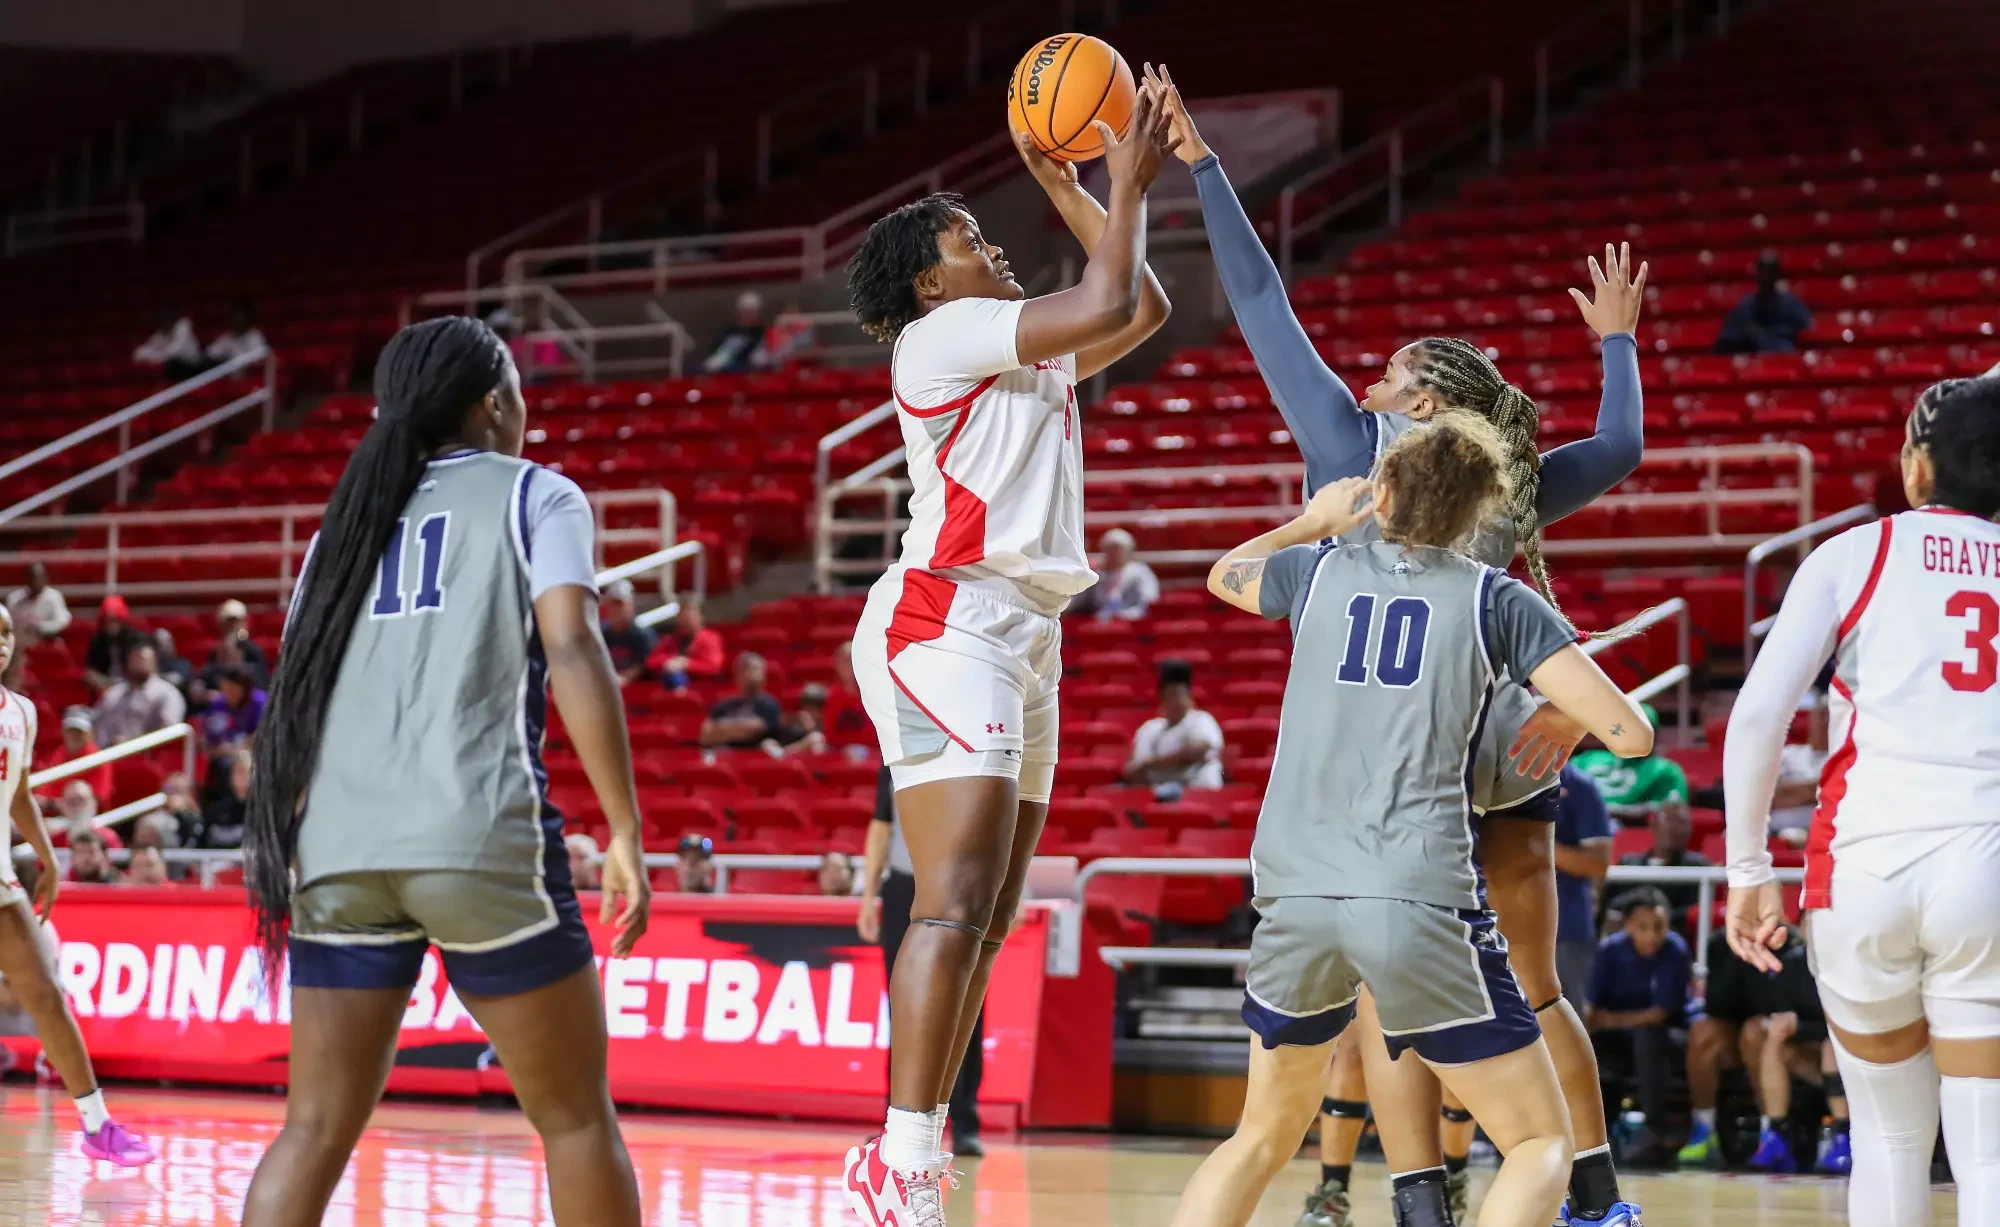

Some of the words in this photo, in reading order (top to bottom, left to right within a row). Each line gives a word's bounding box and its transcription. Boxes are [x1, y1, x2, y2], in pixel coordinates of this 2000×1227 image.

[1027, 36, 1072, 107] Wilson
[369, 510, 451, 620] 11
[1335, 592, 1433, 689] 10
[1941, 590, 2000, 692] 3
